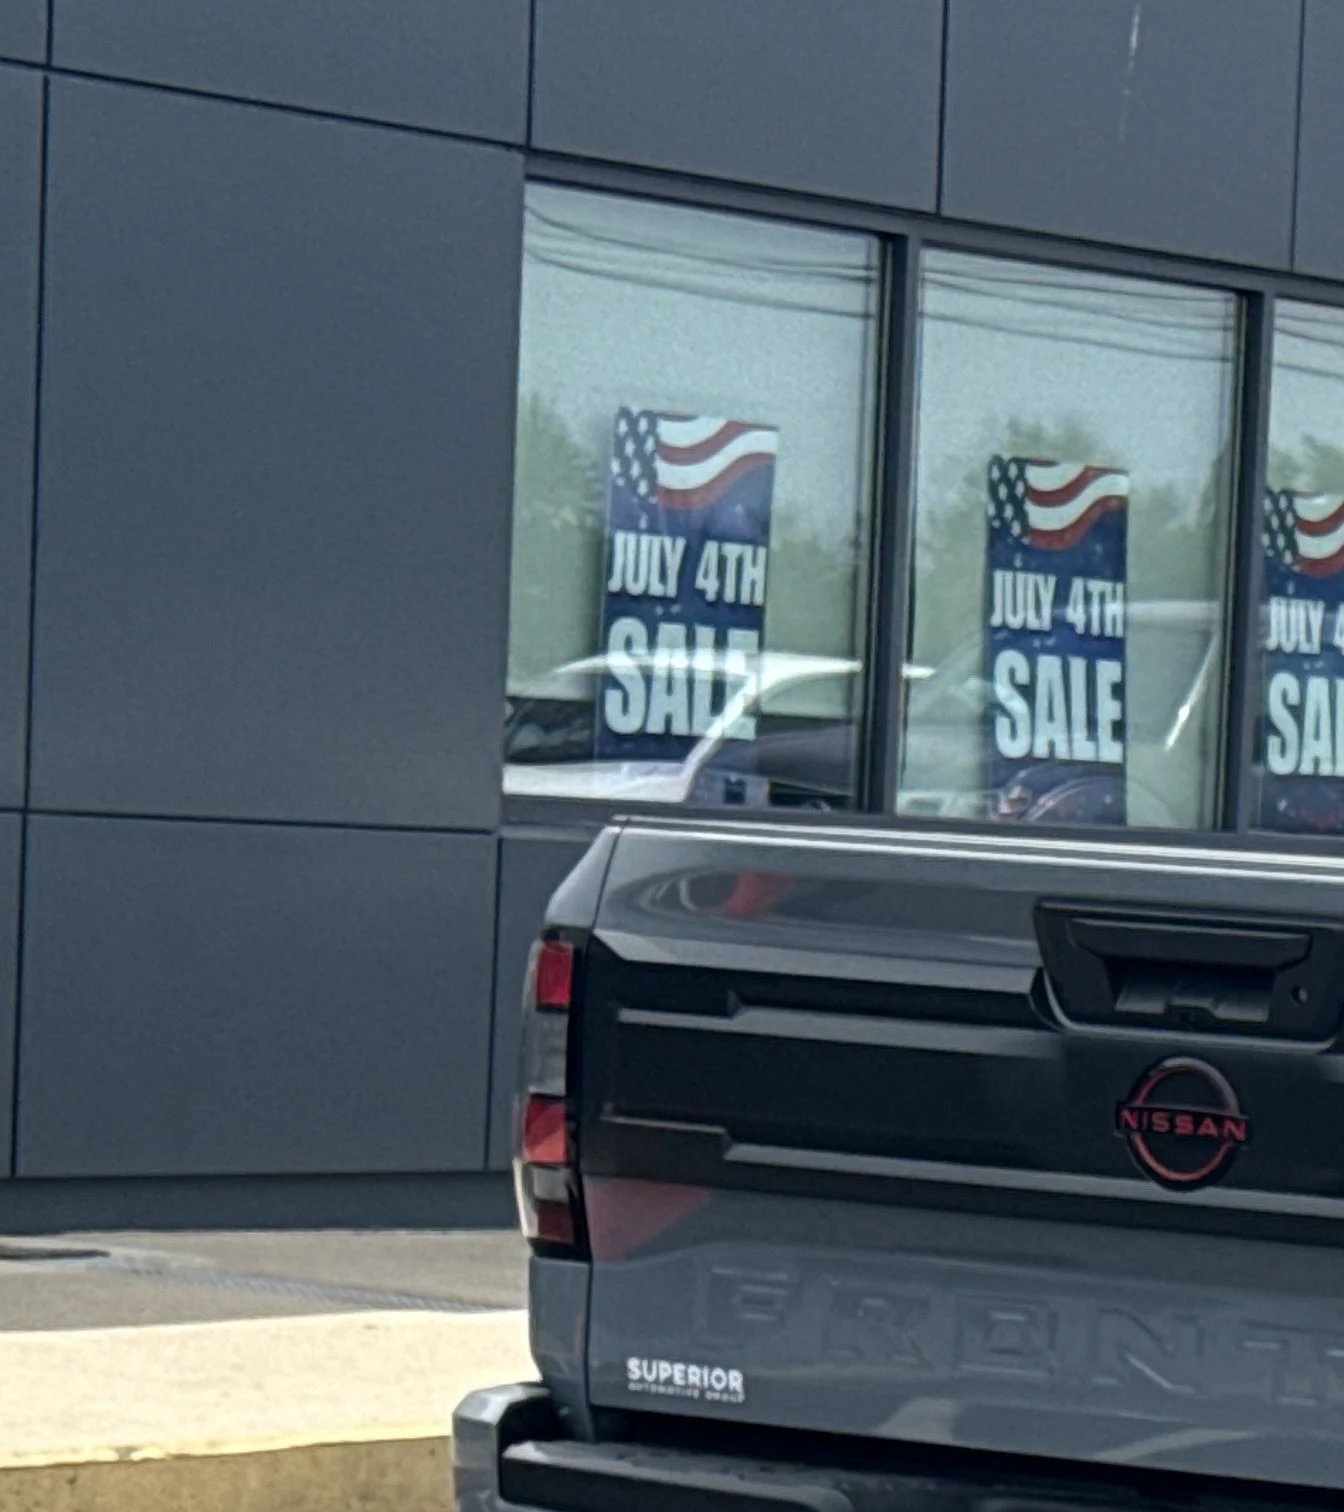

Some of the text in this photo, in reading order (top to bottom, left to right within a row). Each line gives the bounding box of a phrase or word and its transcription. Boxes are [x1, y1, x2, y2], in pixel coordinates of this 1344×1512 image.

[608, 532, 768, 606] JULY 4TH
[990, 570, 1124, 638] JULY 4TH
[1264, 597, 1326, 655] JULY
[604, 617, 760, 741] SALE
[993, 650, 1123, 764] SALE
[1119, 1105, 1248, 1142] NISSAN
[626, 1356, 744, 1393] SUPERIOR
